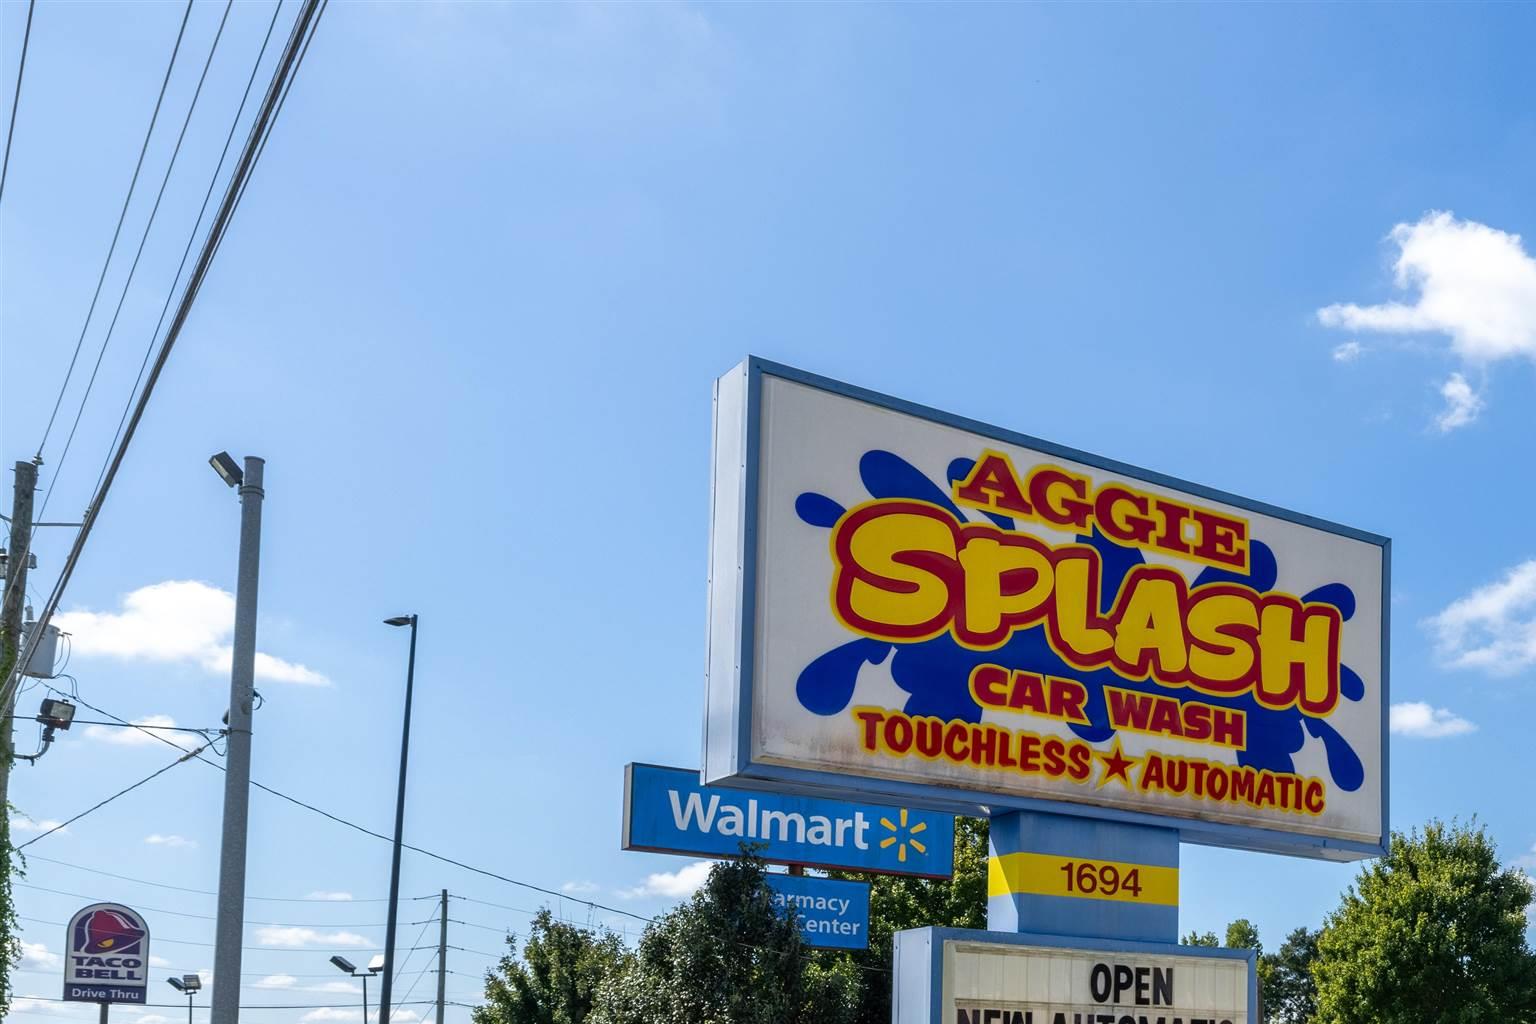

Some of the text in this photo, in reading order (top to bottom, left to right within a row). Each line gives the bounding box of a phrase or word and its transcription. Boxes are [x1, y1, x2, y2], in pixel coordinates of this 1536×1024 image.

[956, 454, 1248, 569] AGGIE
[834, 502, 1340, 714] SPLASH
[972, 667, 1246, 747] CAR WASH
[857, 711, 1325, 812] TOUCHLESS AUTOMATIC
[668, 789, 870, 850] Walmart
[1060, 862, 1143, 897] 1694
[772, 892, 850, 916] armacy
[71, 956, 142, 969] TACO
[75, 968, 142, 981] BELL
[1090, 962, 1174, 1006] OPEN
[71, 988, 139, 999] Drive Thru
